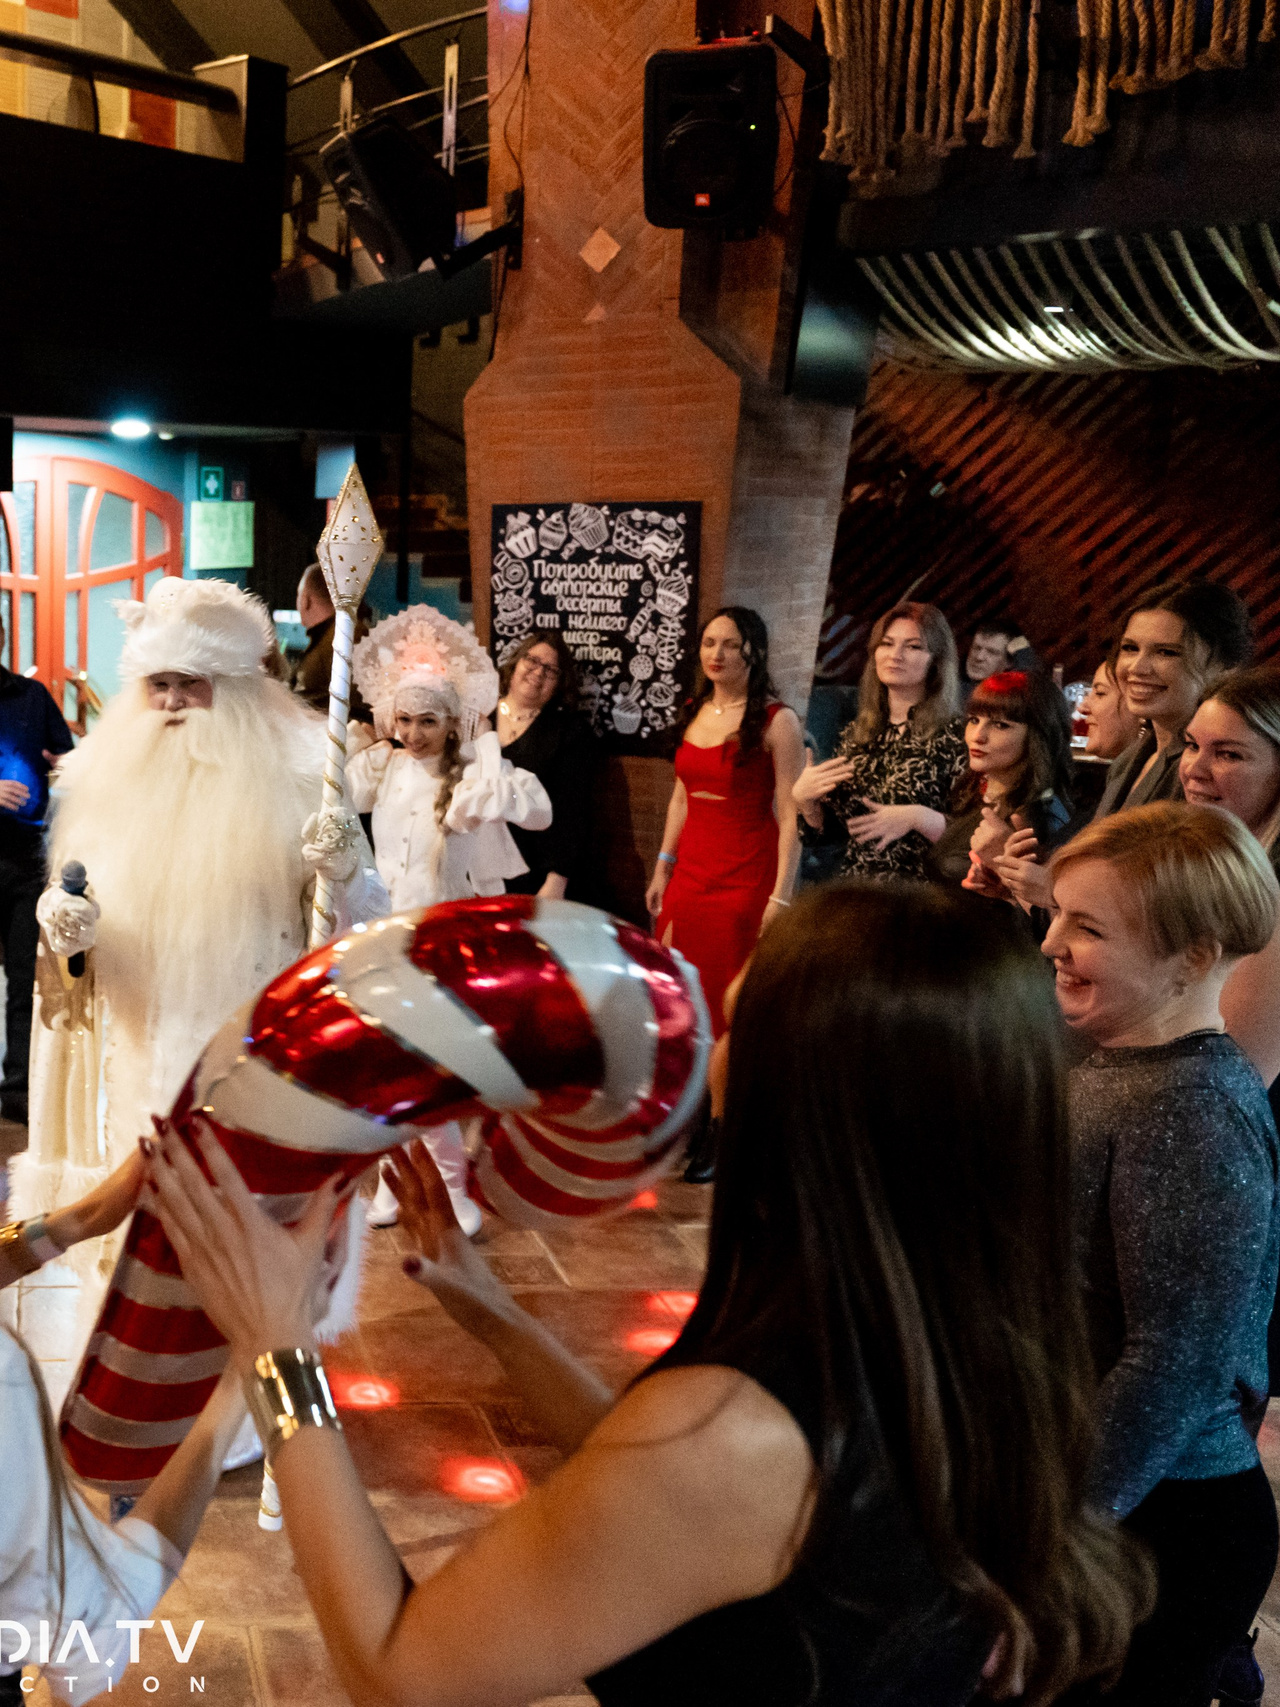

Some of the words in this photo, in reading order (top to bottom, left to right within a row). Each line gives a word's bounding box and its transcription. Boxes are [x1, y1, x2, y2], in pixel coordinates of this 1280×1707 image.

[533, 557, 644, 582] Попробуйте
[541, 580, 629, 598] авторские
[536, 613, 560, 629] от
[568, 614, 628, 631] нашего
